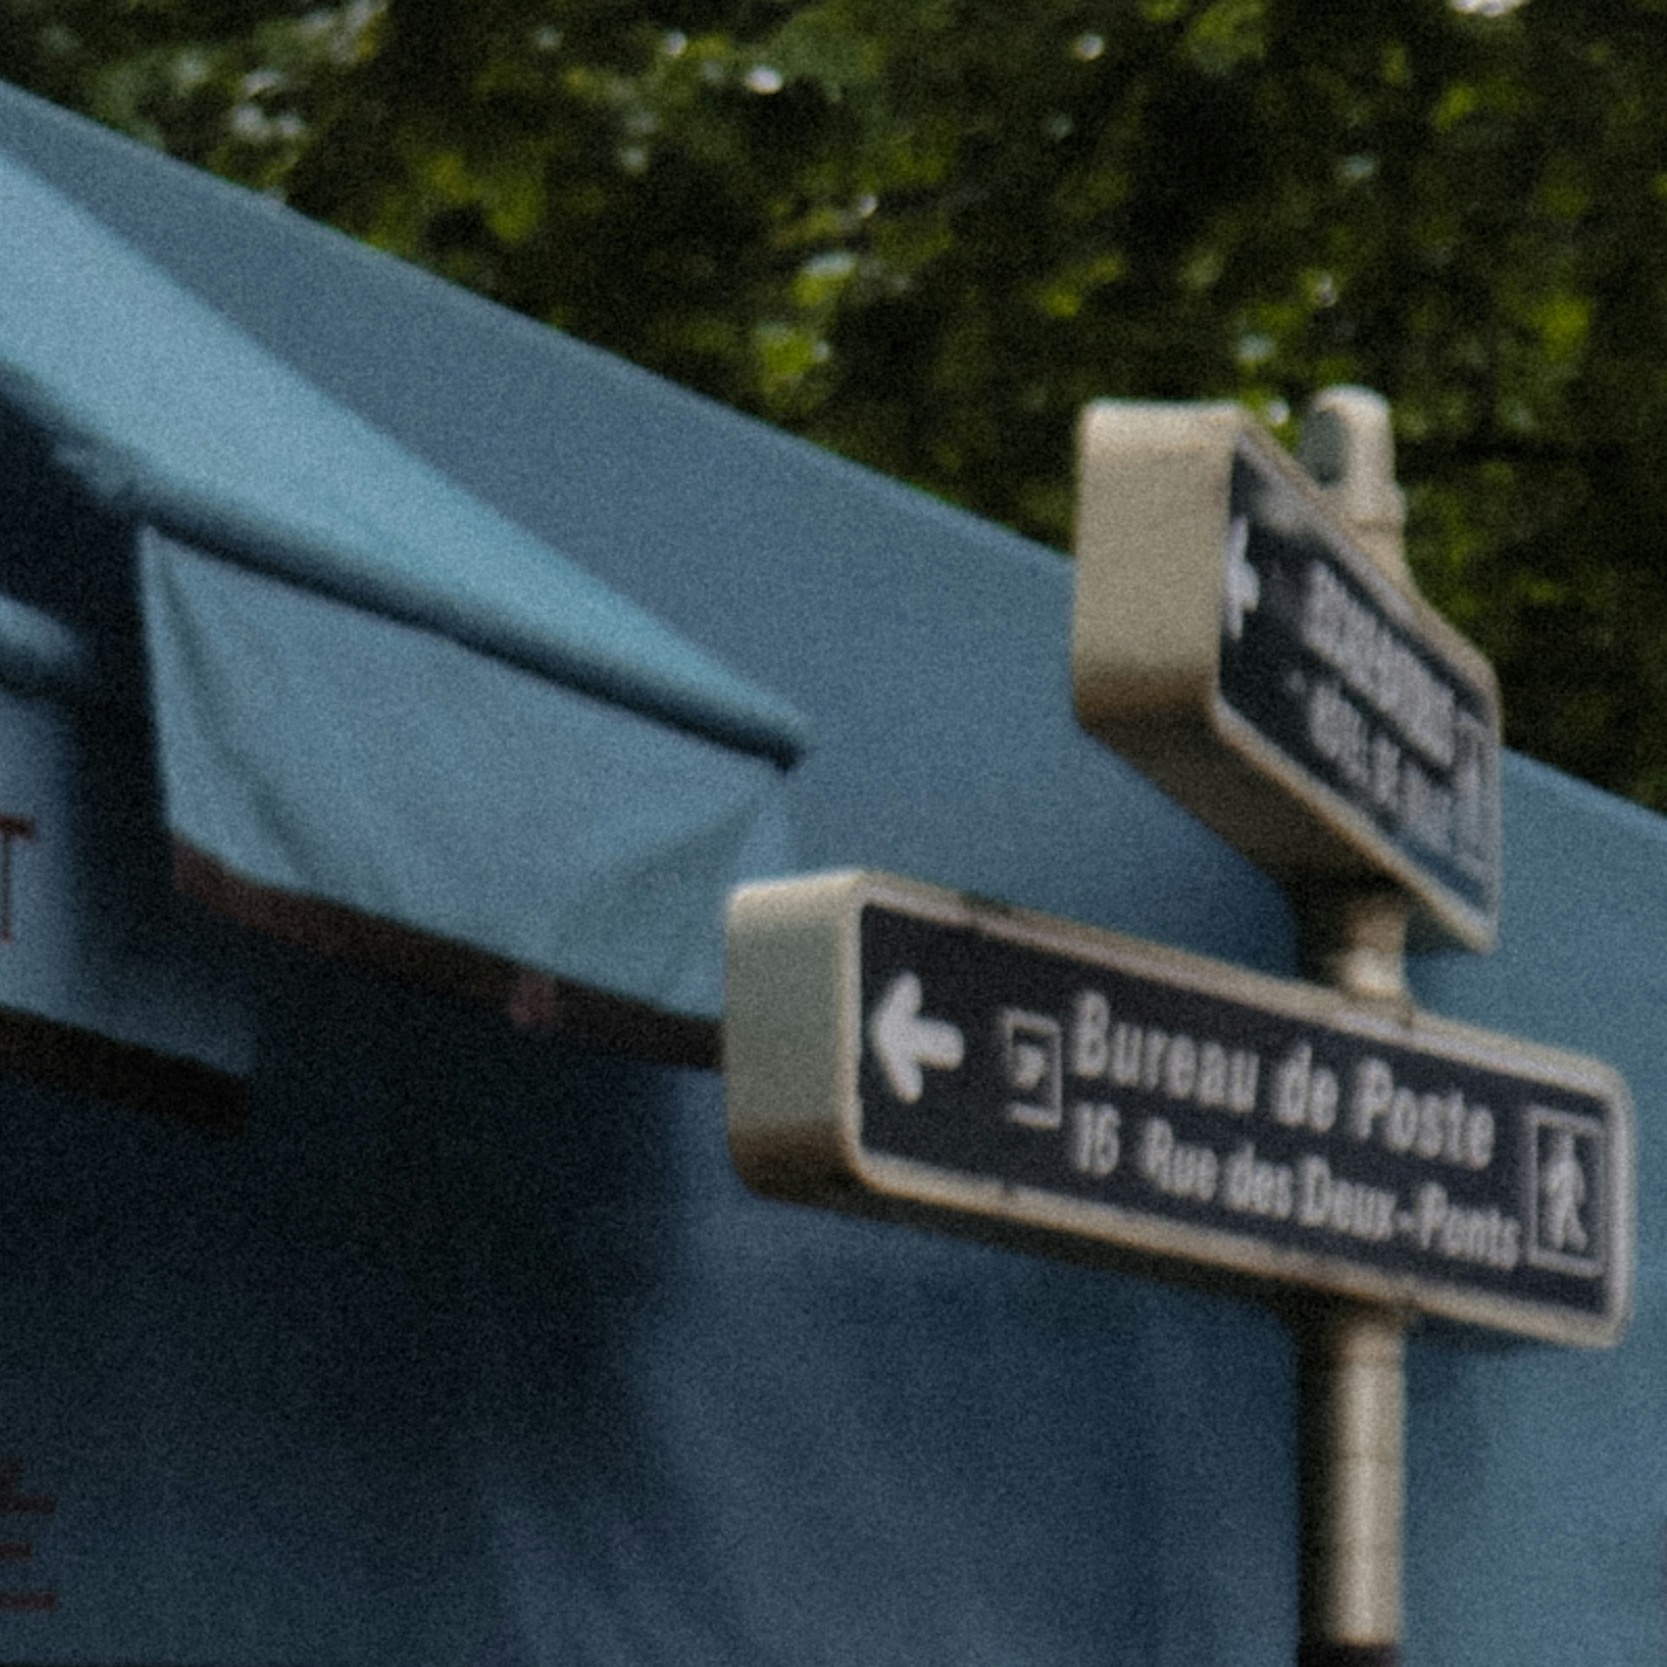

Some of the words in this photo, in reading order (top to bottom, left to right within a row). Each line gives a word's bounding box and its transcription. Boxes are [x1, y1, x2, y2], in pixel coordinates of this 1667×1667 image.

[1071, 991, 1260, 1114] Bureau
[1271, 1039, 1338, 1133] de
[1348, 1056, 1496, 1171] Poste
[1137, 1115, 1219, 1202] Rue
[1223, 1140, 1294, 1220] des
